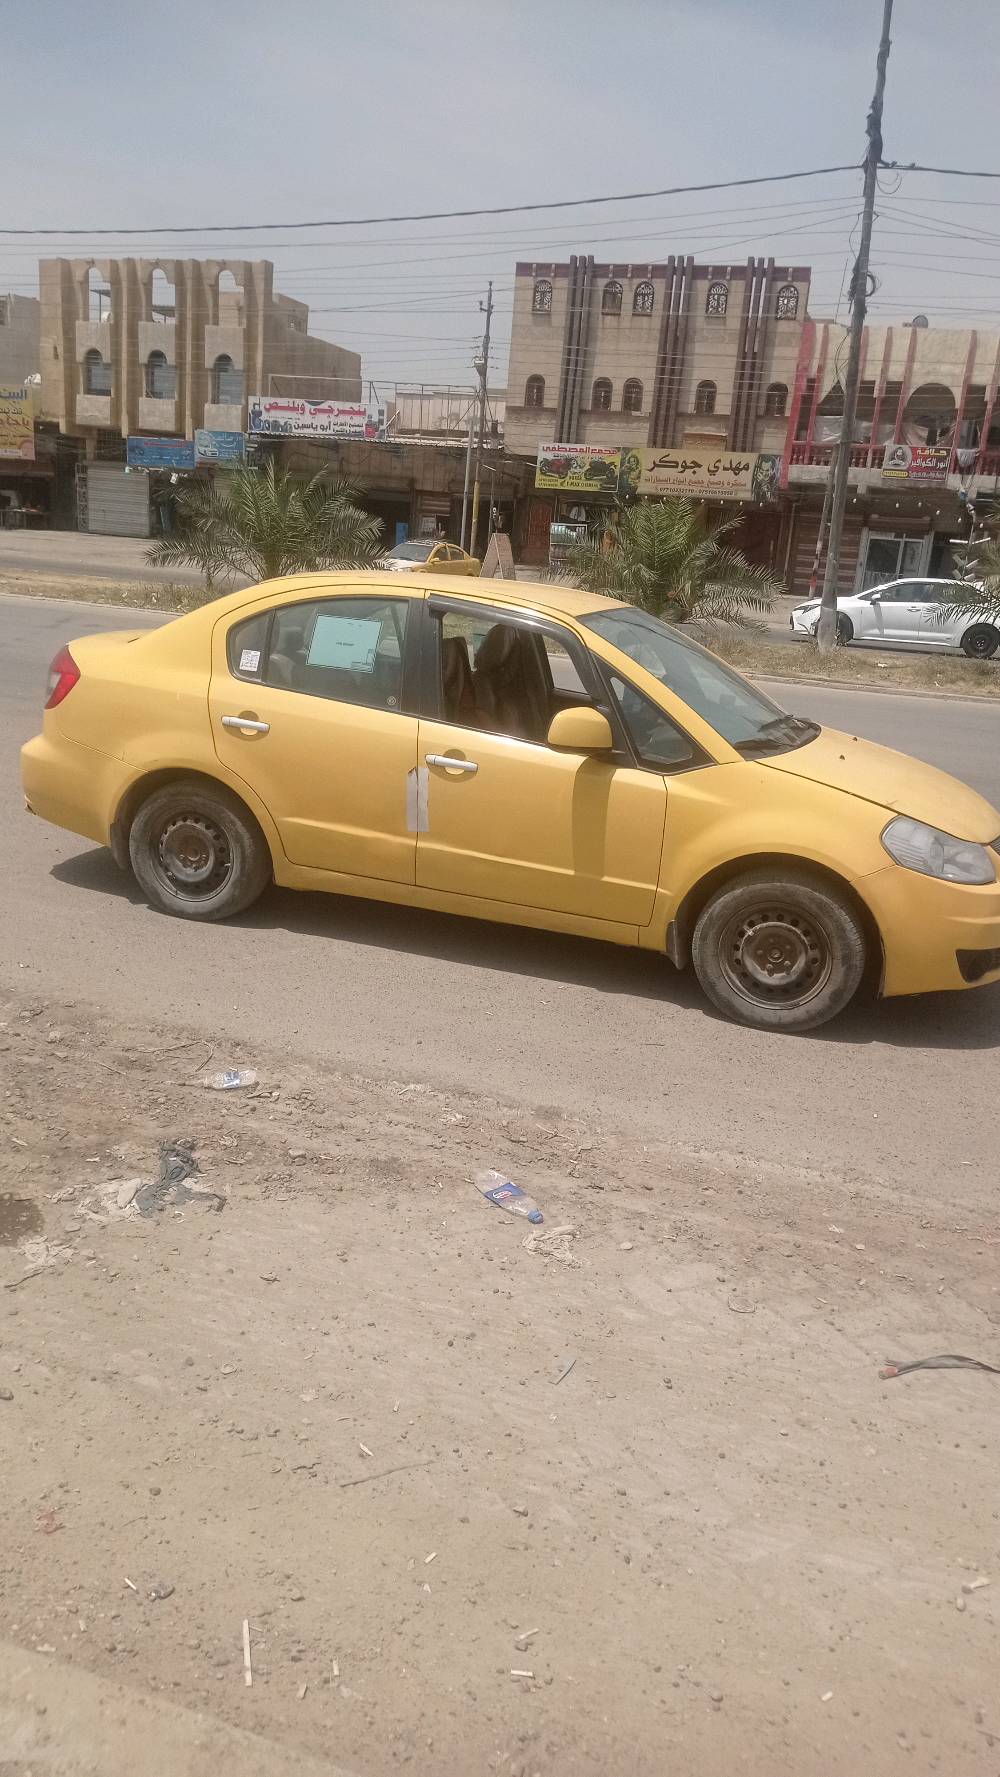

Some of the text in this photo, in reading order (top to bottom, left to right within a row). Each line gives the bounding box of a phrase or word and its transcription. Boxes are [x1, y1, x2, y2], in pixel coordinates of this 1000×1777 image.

[293, 420, 318, 431] ياسين
[916, 448, 947, 456] حلاقة
[646, 453, 750, 476] مهدي جوكر
